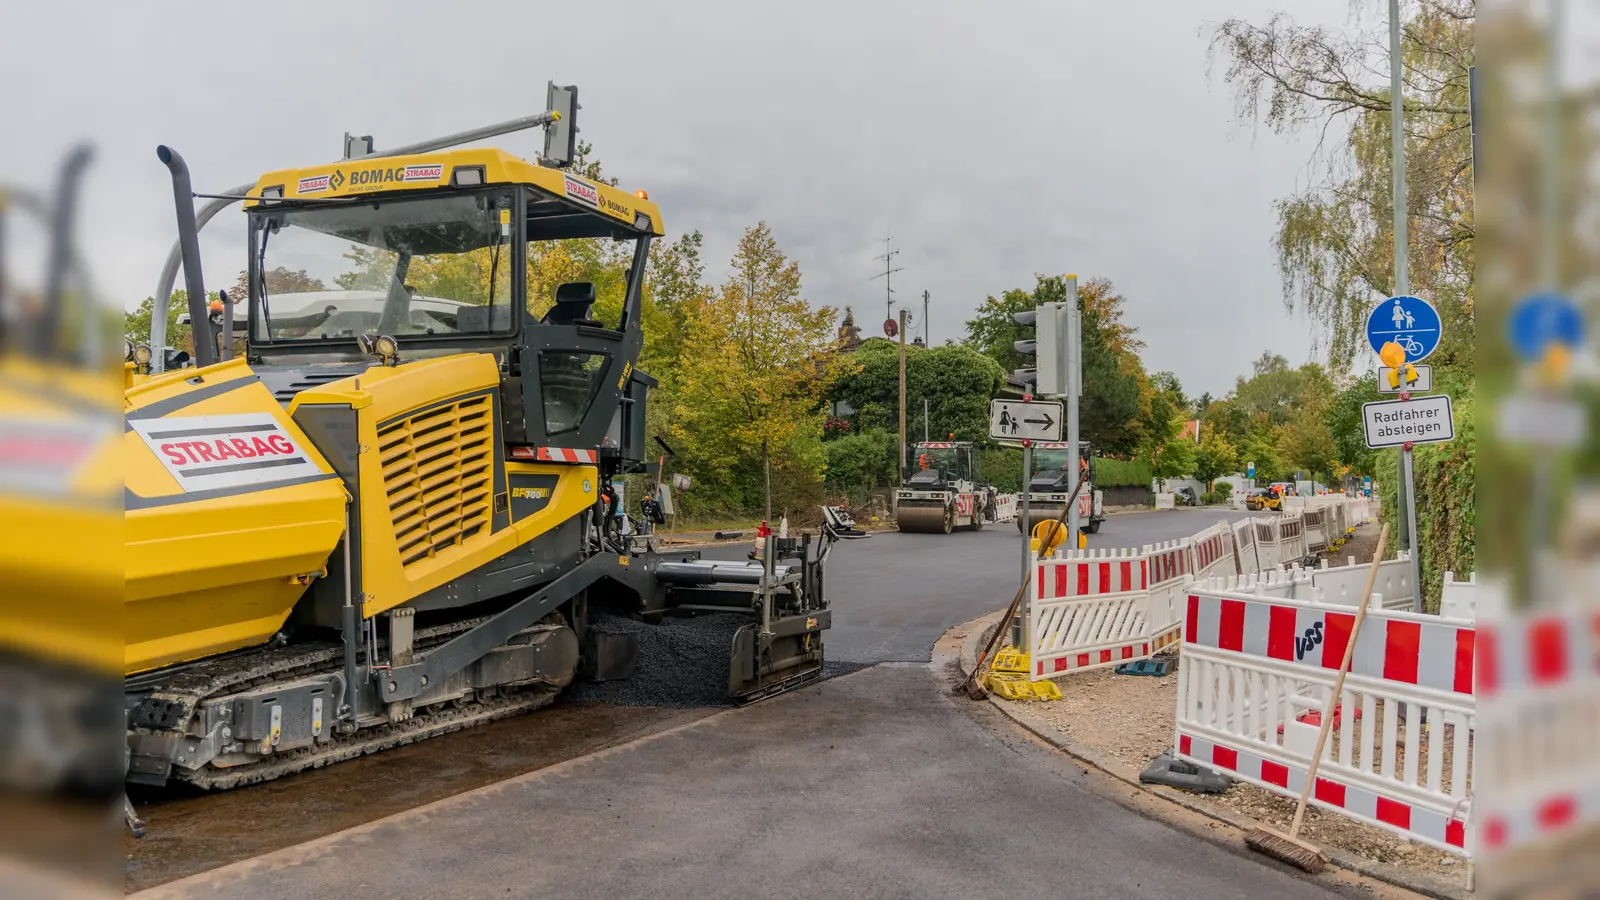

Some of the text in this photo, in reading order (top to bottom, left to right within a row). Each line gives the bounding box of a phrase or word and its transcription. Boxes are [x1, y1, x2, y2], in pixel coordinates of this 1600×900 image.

[349, 167, 405, 185] BOMAG
[404, 168, 440, 177] STRABAG
[299, 179, 328, 190] STRABAG
[565, 181, 597, 201] STRABAG
[607, 200, 629, 217] BOMAG
[1374, 408, 1440, 423] Radfahrer
[1378, 422, 1441, 437] absteigen
[161, 434, 295, 466] STRABAG
[1295, 621, 1323, 661] VSS
